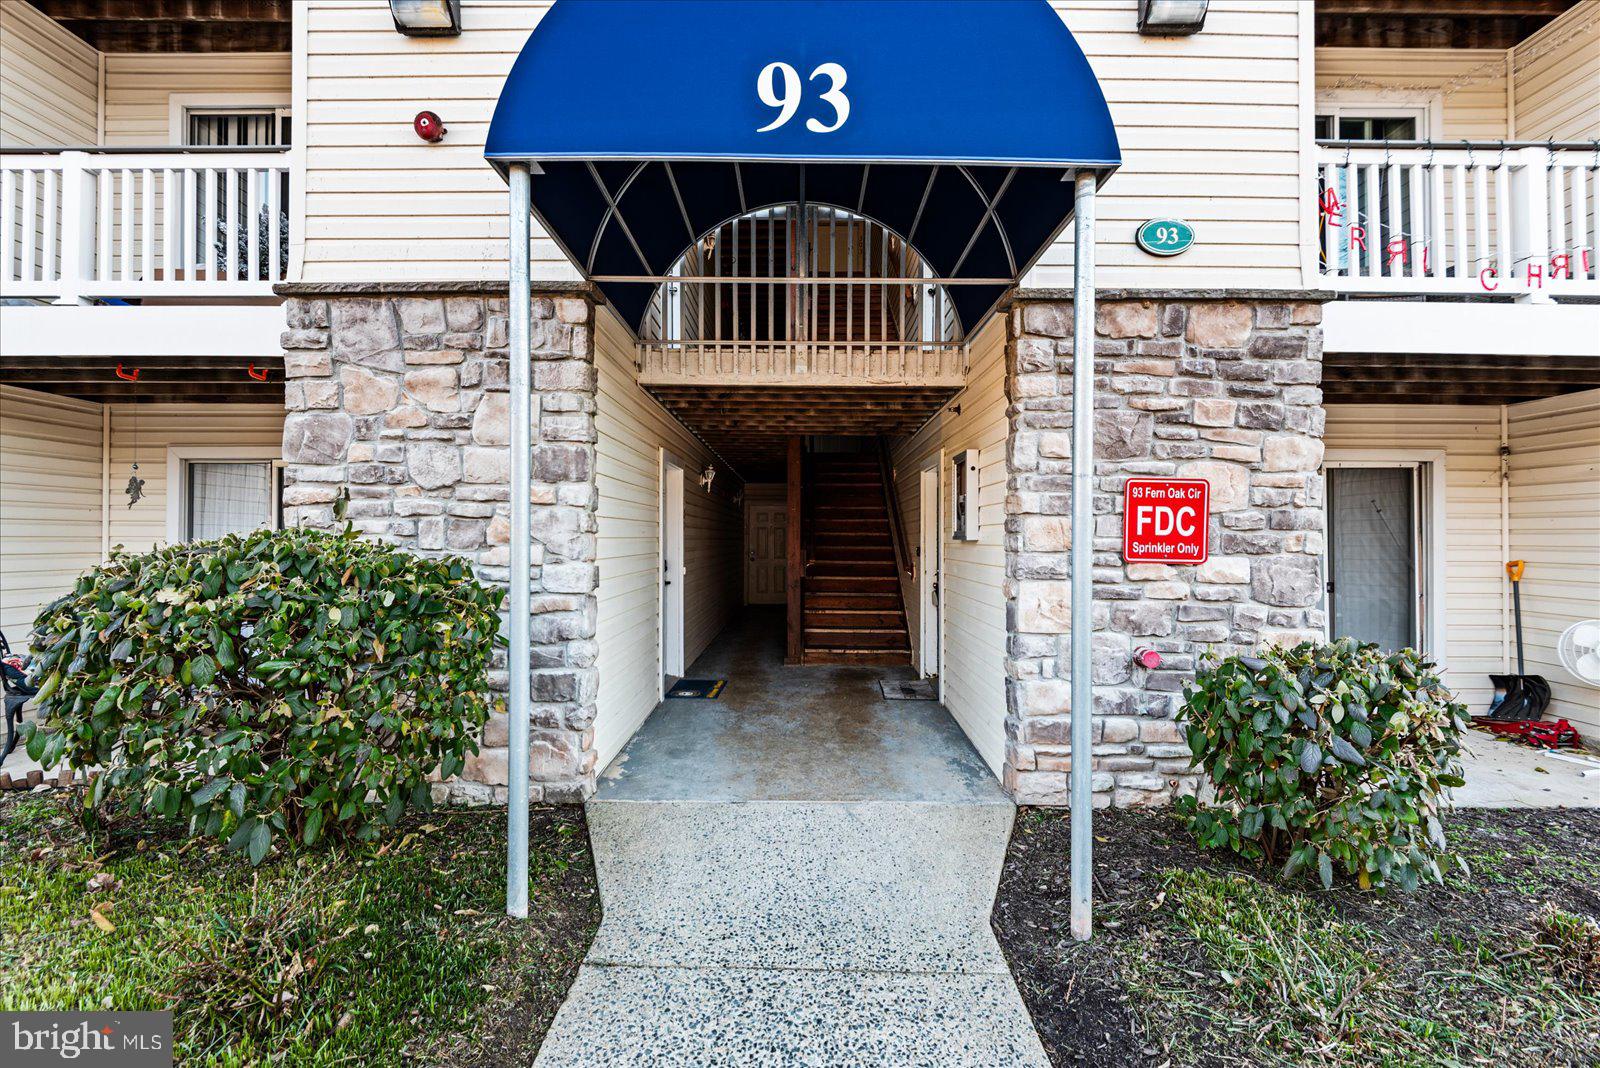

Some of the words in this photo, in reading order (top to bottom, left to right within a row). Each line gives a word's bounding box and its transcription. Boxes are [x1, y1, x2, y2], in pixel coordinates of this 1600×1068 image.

[756, 61, 851, 133] 93
[1156, 227, 1179, 245] 93
[1132, 487, 1143, 498] 93
[1145, 487, 1166, 498] Fern
[1167, 487, 1186, 499] Oak
[1187, 488, 1202, 499] Cir
[1136, 505, 1197, 537] FDC
[1132, 541, 1175, 555] Sprinkler
[1177, 542, 1200, 556] Only
